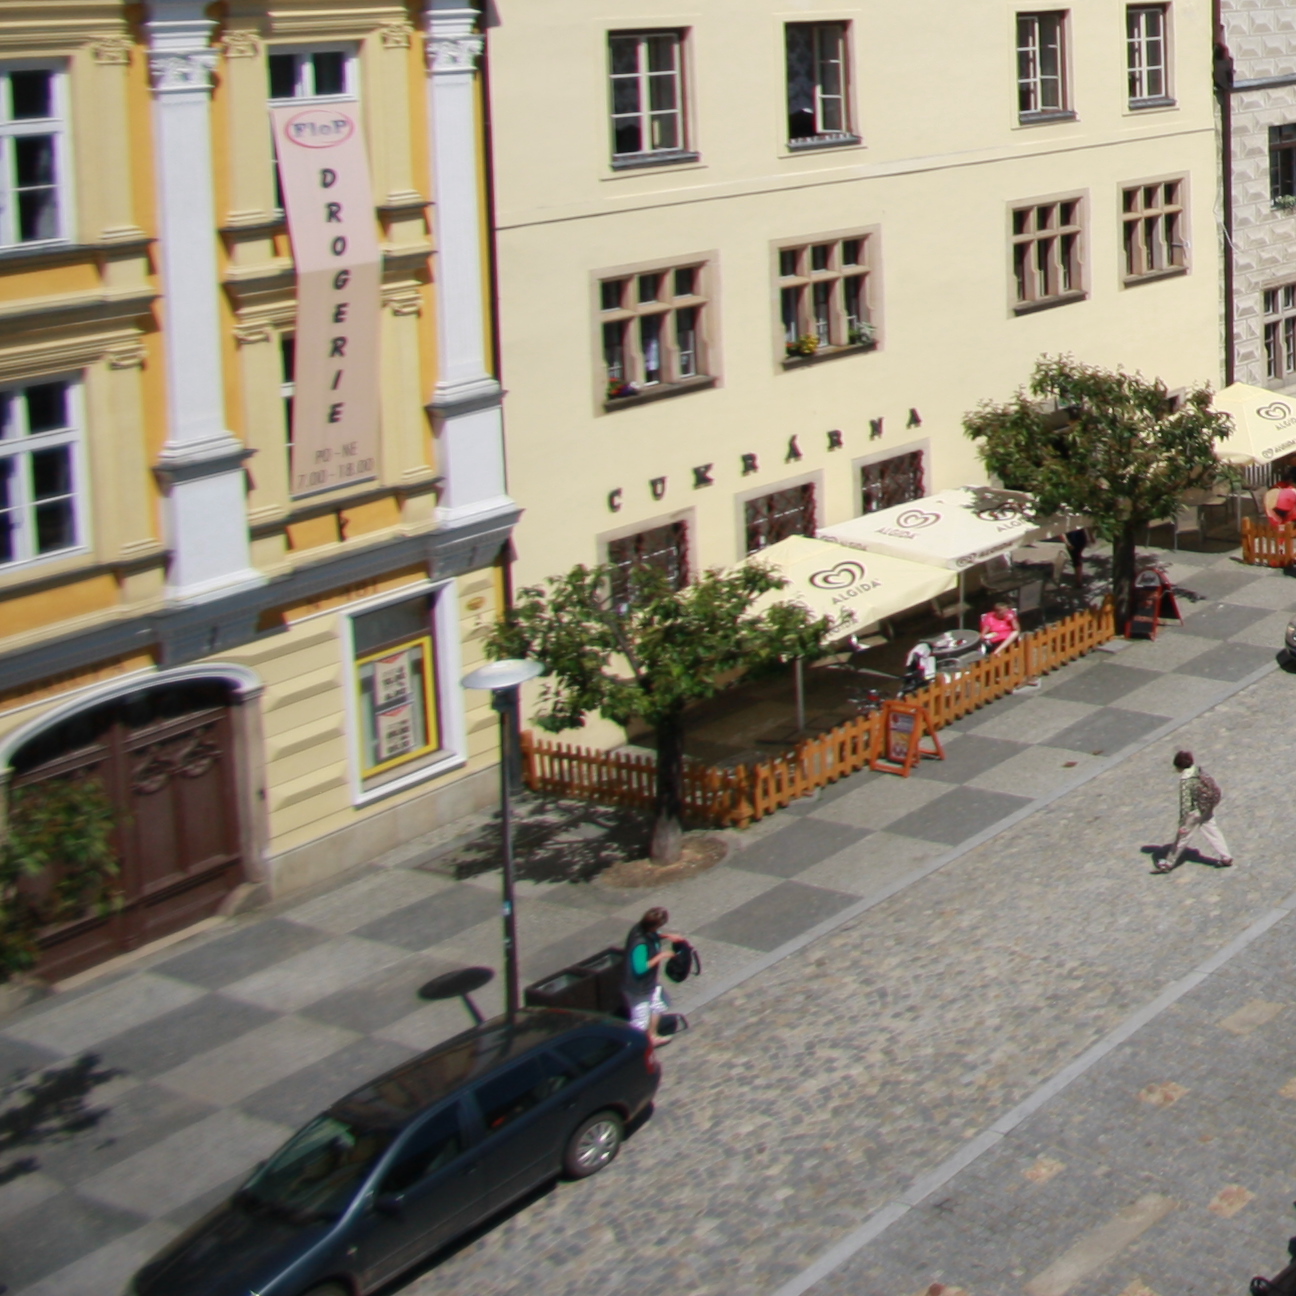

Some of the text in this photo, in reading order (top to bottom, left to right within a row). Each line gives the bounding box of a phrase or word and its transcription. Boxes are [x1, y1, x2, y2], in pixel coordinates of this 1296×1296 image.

[320, 167, 351, 424] DROGERIE
[608, 408, 922, 513] CUKRÁRNA
[832, 581, 879, 605] ALGIDA
